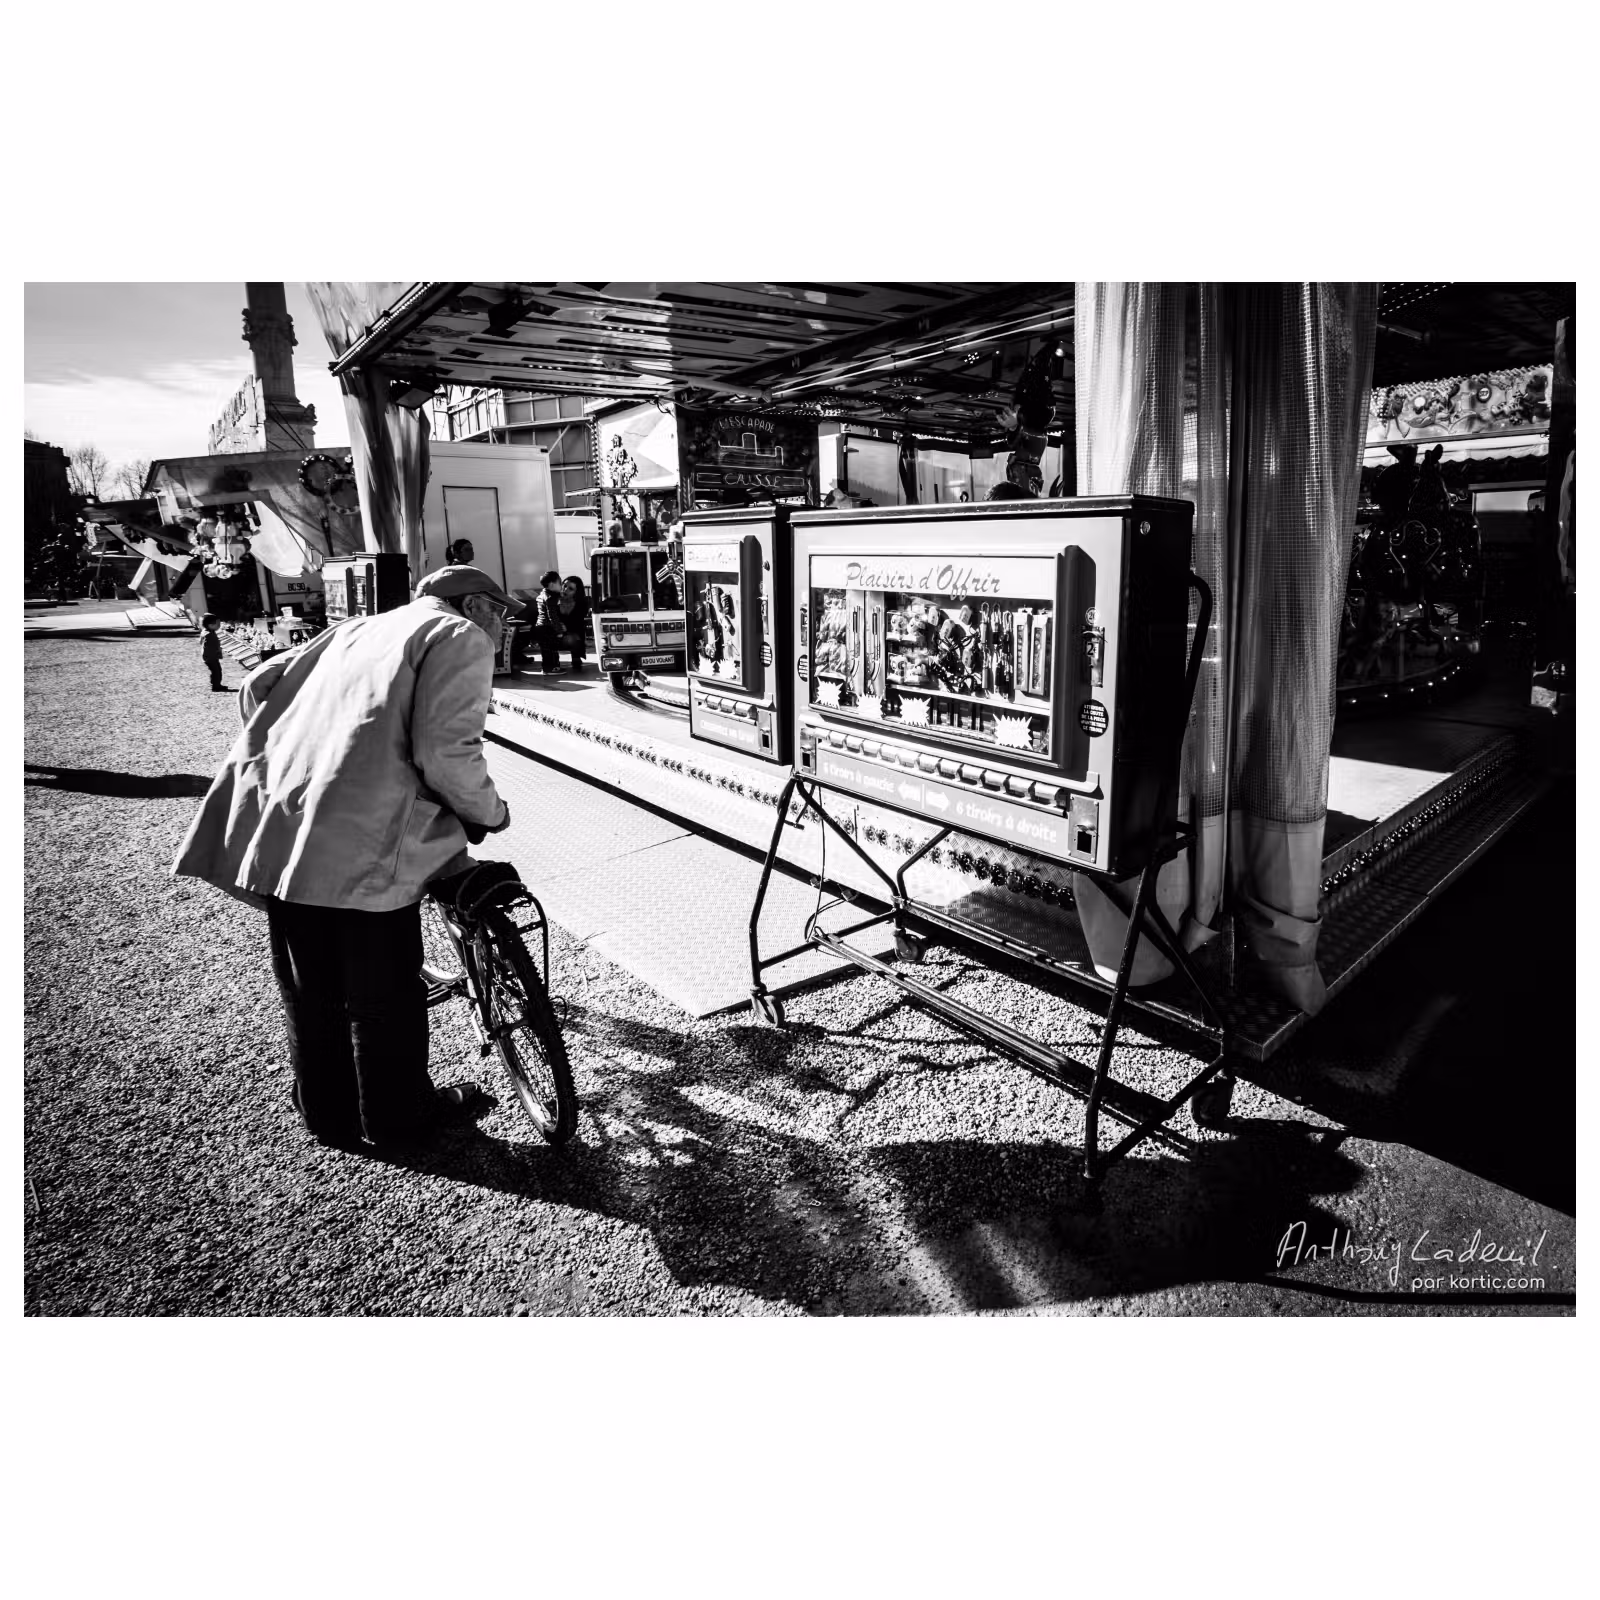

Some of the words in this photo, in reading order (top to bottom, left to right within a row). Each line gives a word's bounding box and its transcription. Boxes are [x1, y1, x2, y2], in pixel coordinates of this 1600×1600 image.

[724, 473, 781, 488] CAISSE
[846, 562, 914, 589] Plaisirs
[919, 564, 1001, 601] d'Offrir
[956, 802, 964, 815] 6
[965, 803, 1004, 827] tiroirs
[1005, 814, 1015, 831] à
[1016, 818, 1057, 843] droite
